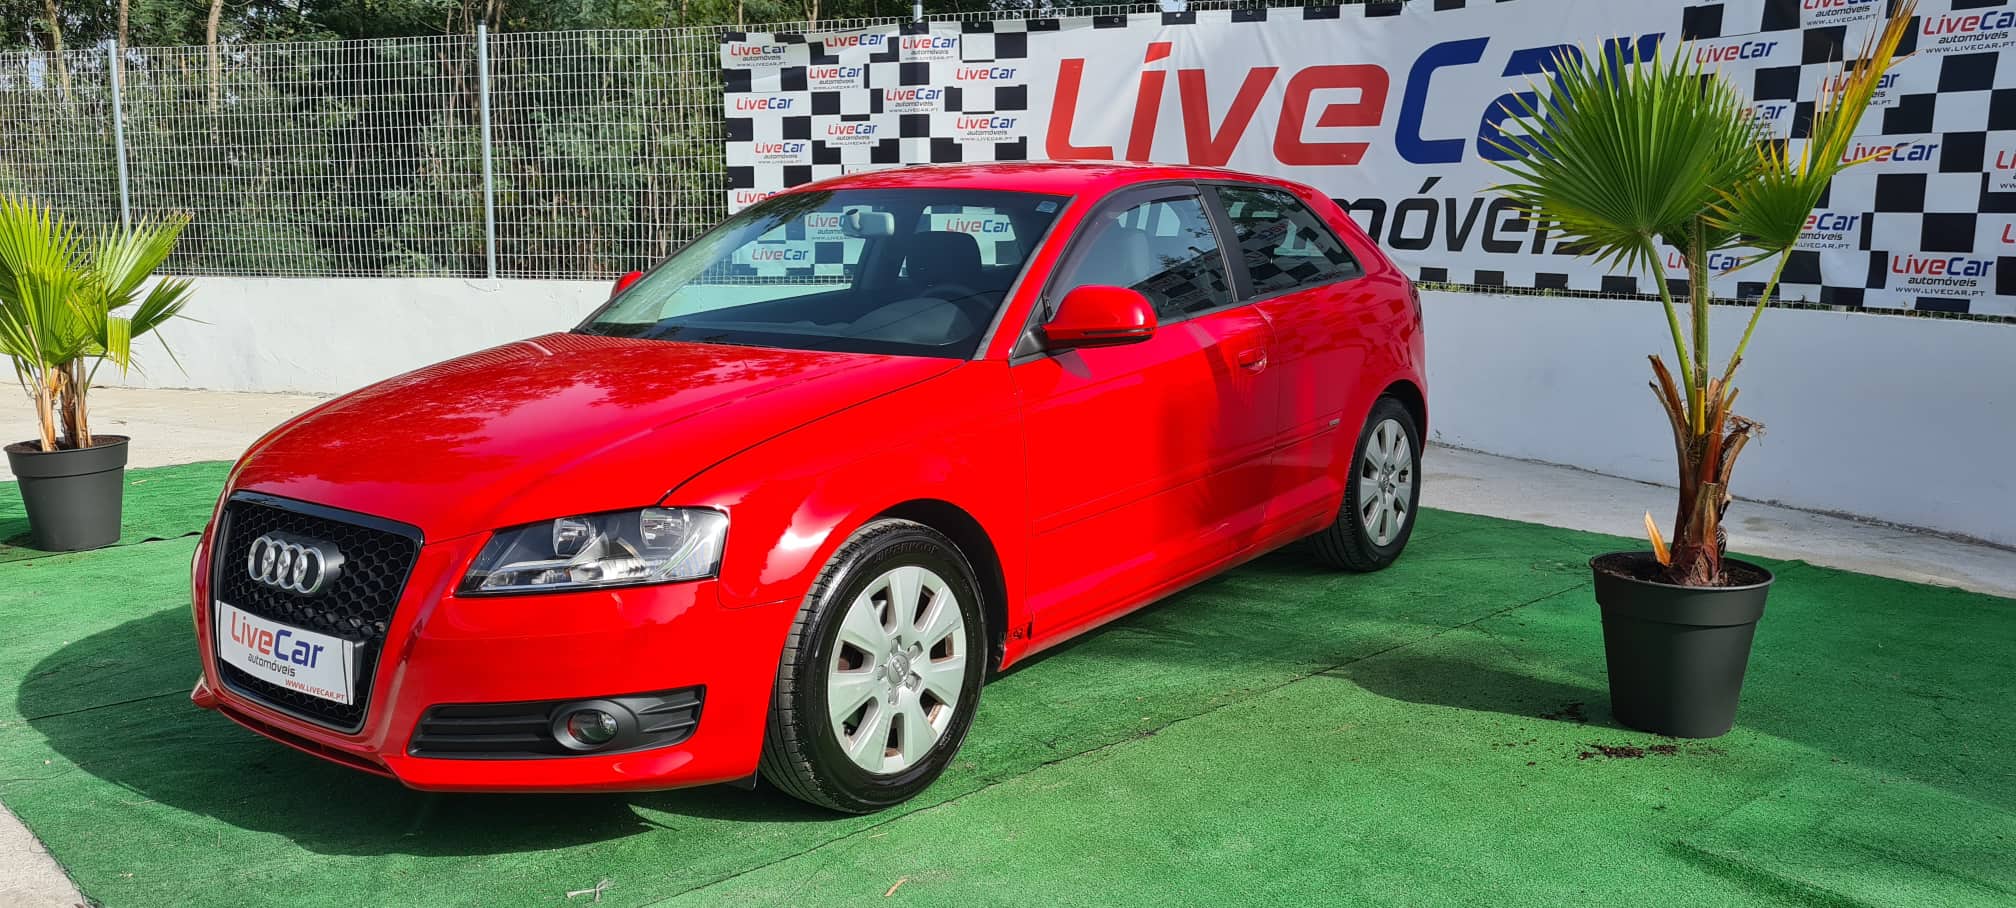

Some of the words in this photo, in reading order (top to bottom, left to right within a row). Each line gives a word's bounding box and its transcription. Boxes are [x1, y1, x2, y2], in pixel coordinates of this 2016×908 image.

[1815, 5, 1870, 17] automóveis
[1806, 14, 1877, 26] WWW.LIVECAR.PT
[1923, 11, 2016, 35] LiveCa
[825, 33, 886, 47] LiveCar
[902, 36, 957, 49] LiveCar
[1938, 31, 2009, 44] automóveis
[730, 43, 787, 56] LiveCar
[1696, 41, 1778, 64] LiveCar
[1925, 41, 2016, 53] WWW.LIVECAR.PT
[809, 67, 862, 79] LiveCar
[956, 67, 1016, 80] LiveCar
[1822, 73, 1900, 92] Livar
[886, 88, 943, 101] LiveCar
[736, 97, 793, 110] LiveCar
[828, 123, 877, 135] LiveCar
[956, 116, 1017, 129] LiveCar
[755, 142, 805, 153] LiveCar
[1841, 142, 1939, 163] LiveCar
[736, 191, 776, 203] Live
[946, 218, 1012, 232] LiveCar
[751, 248, 808, 260] LiveCar
[1892, 254, 1994, 277] LiveCar
[1908, 276, 1977, 287] automóveis
[1895, 287, 1985, 297] WWW.LIVECAR.PT
[231, 611, 325, 669] LiveCar
[247, 653, 296, 678] automóveis
[285, 678, 345, 701] WWW.LIVECAR.PT
